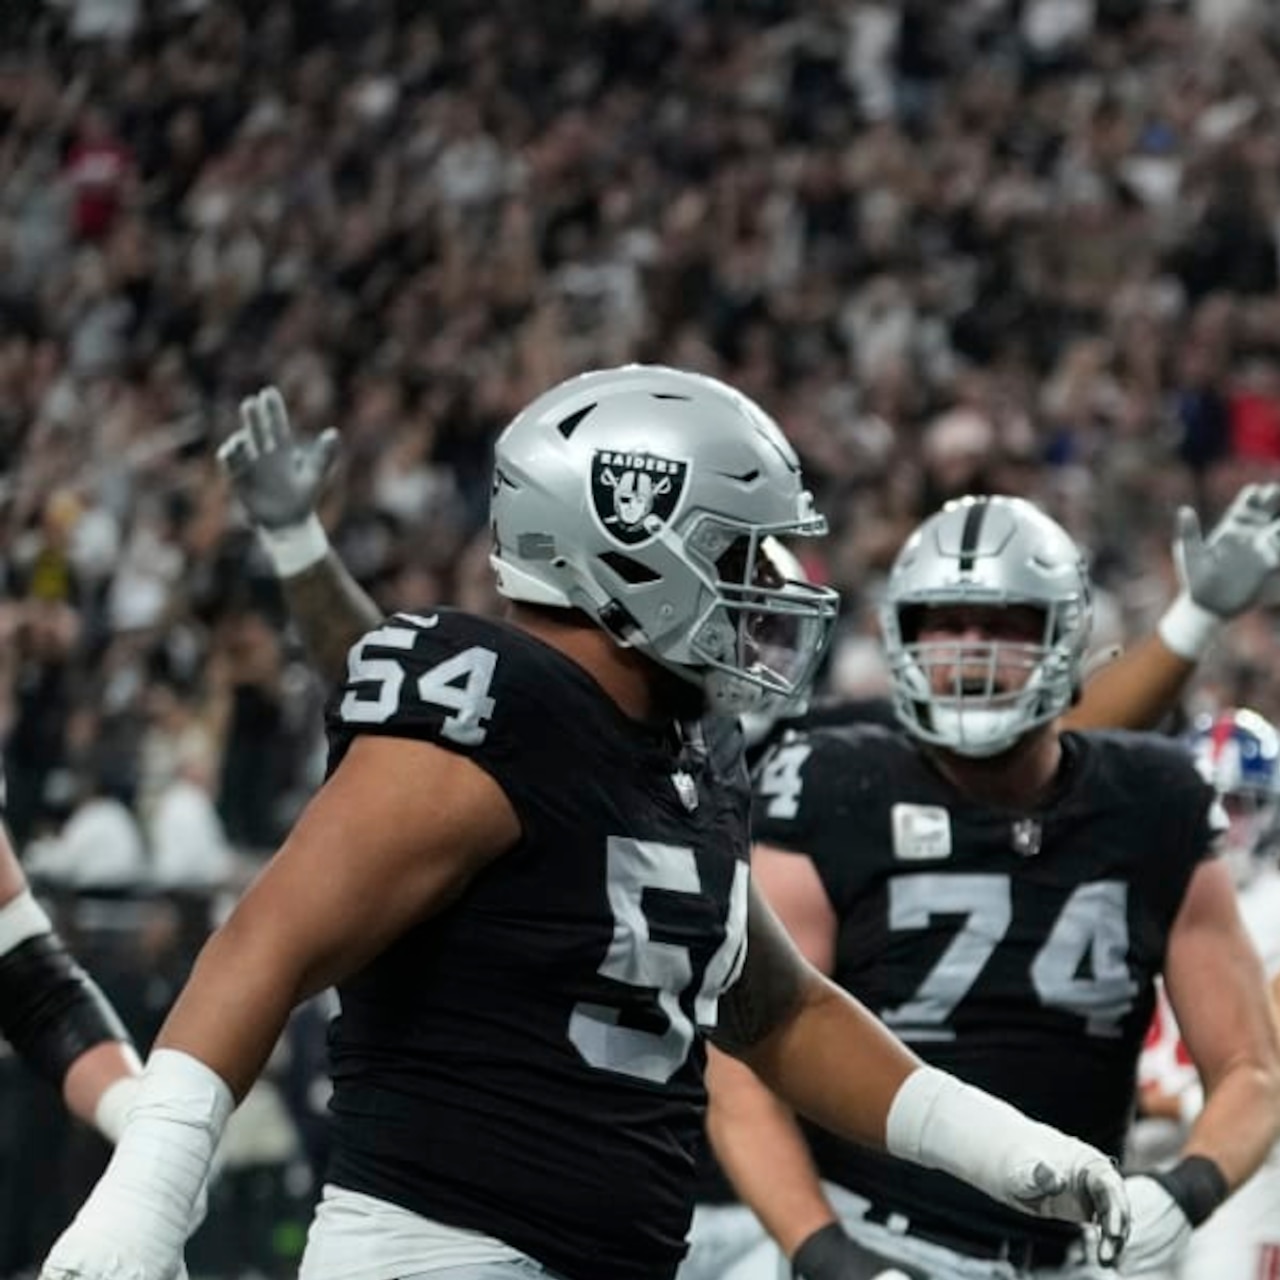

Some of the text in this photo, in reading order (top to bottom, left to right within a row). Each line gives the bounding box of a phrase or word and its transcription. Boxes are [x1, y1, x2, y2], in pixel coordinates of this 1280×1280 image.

[601, 453, 678, 475] RAIDERS
[340, 626, 498, 746] 54
[879, 873, 1138, 1043] 74
